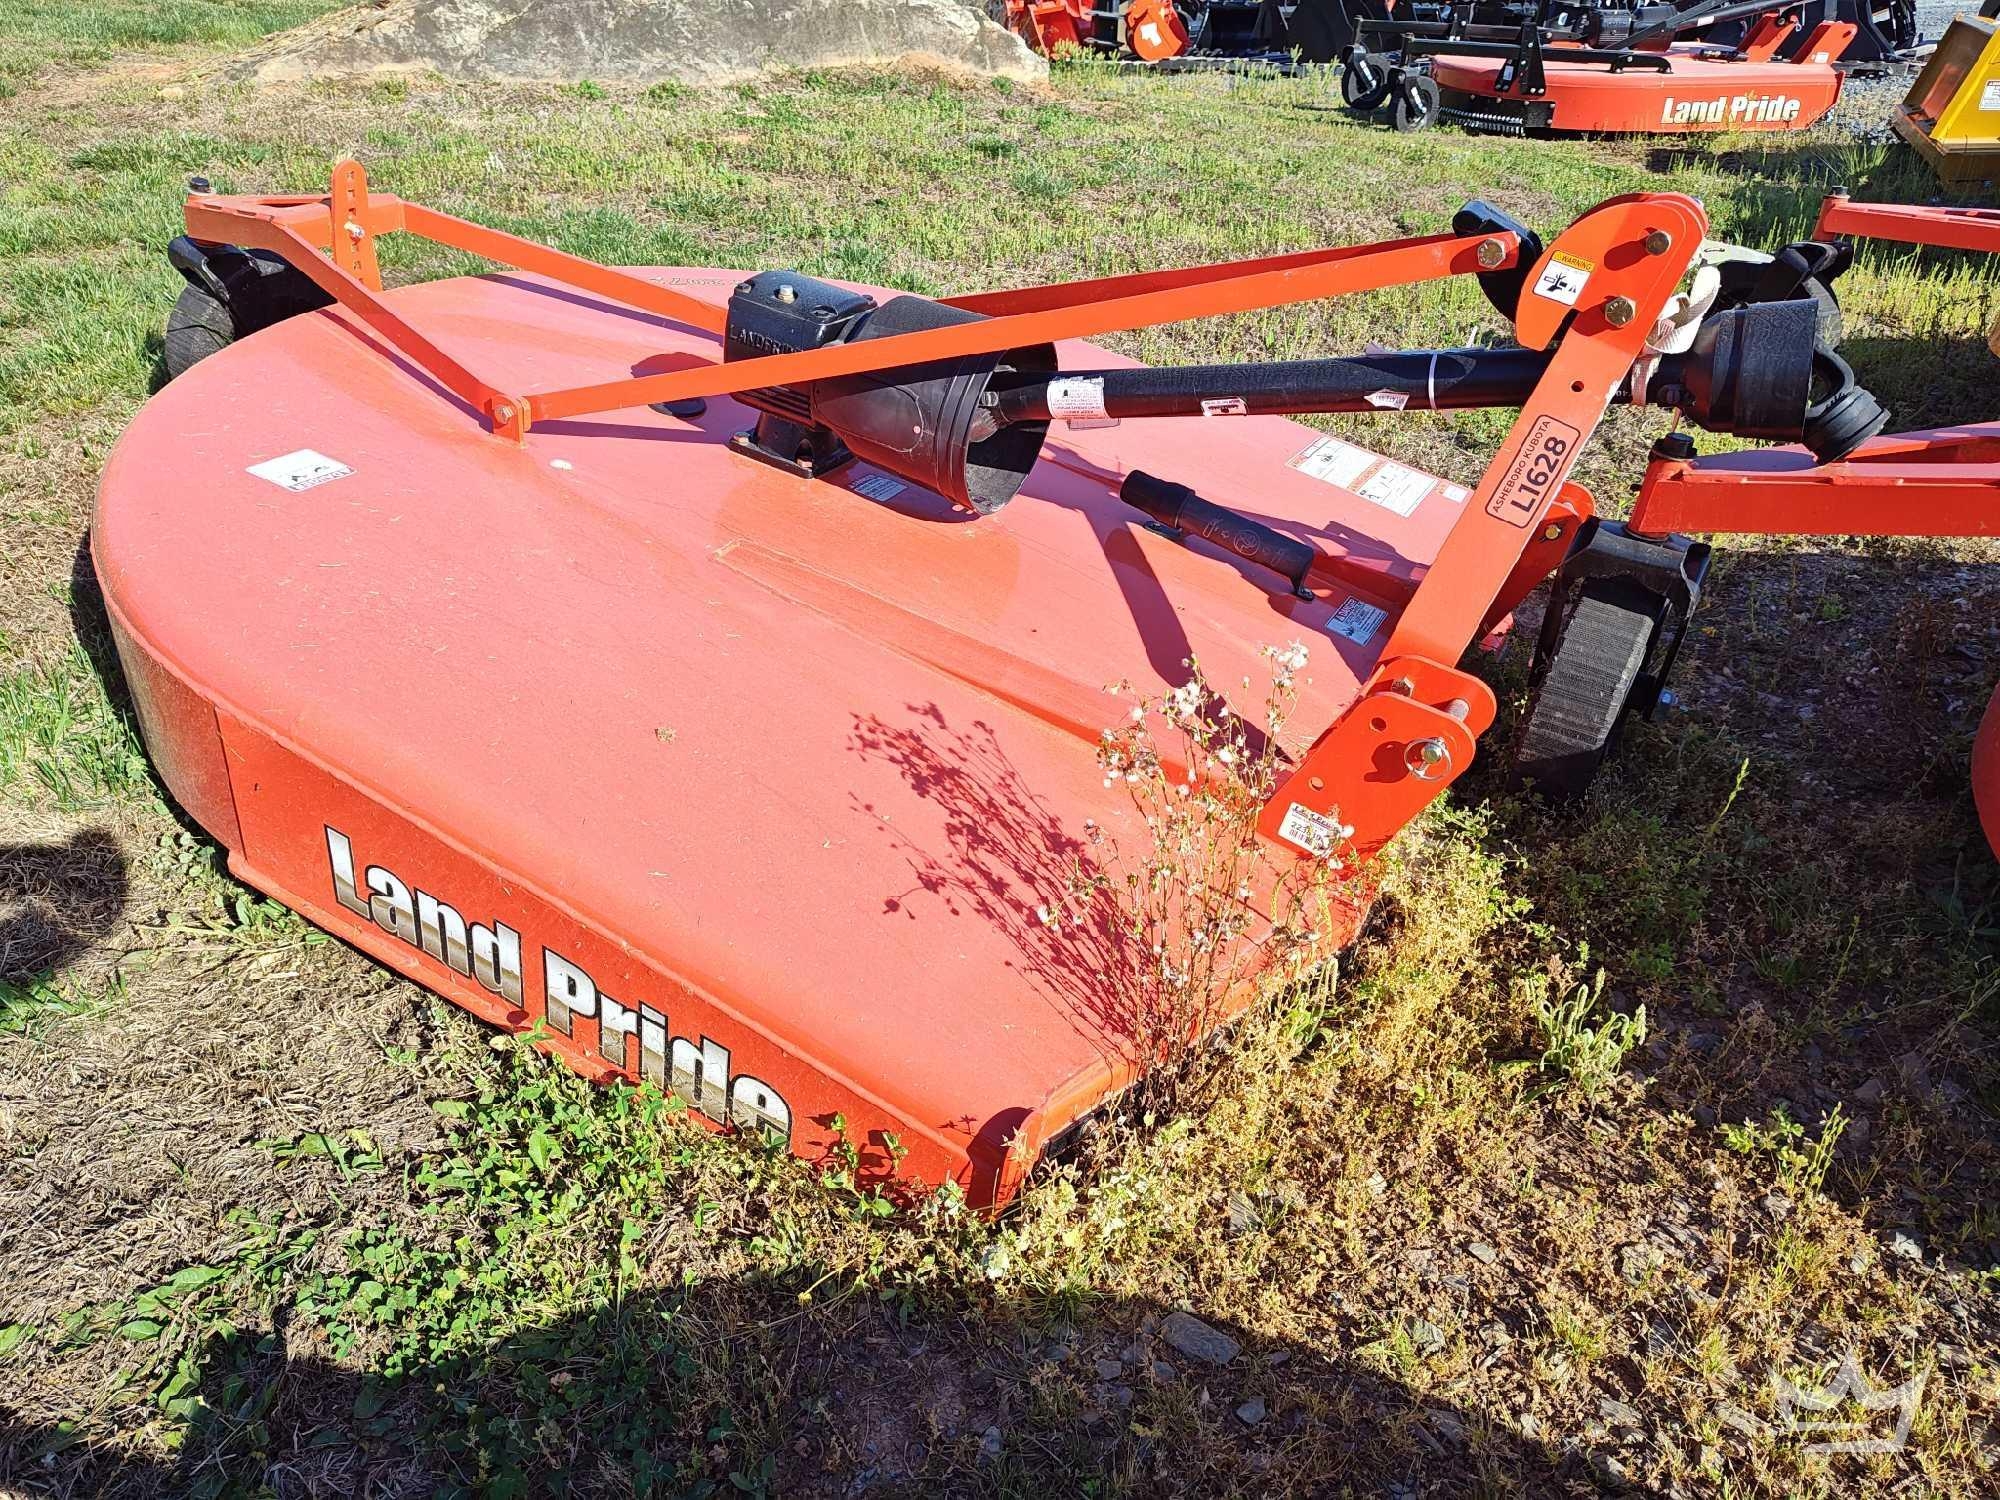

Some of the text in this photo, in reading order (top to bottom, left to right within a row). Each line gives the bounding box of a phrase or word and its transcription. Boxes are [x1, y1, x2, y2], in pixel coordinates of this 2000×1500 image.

[1660, 95, 1801, 124] Land Pride
[1561, 254, 1593, 271] WARNING
[1493, 421, 1551, 513] ASHEBORO KUBOTA
[1510, 436, 1567, 513] L1628
[323, 824, 793, 1152] Land Pride
